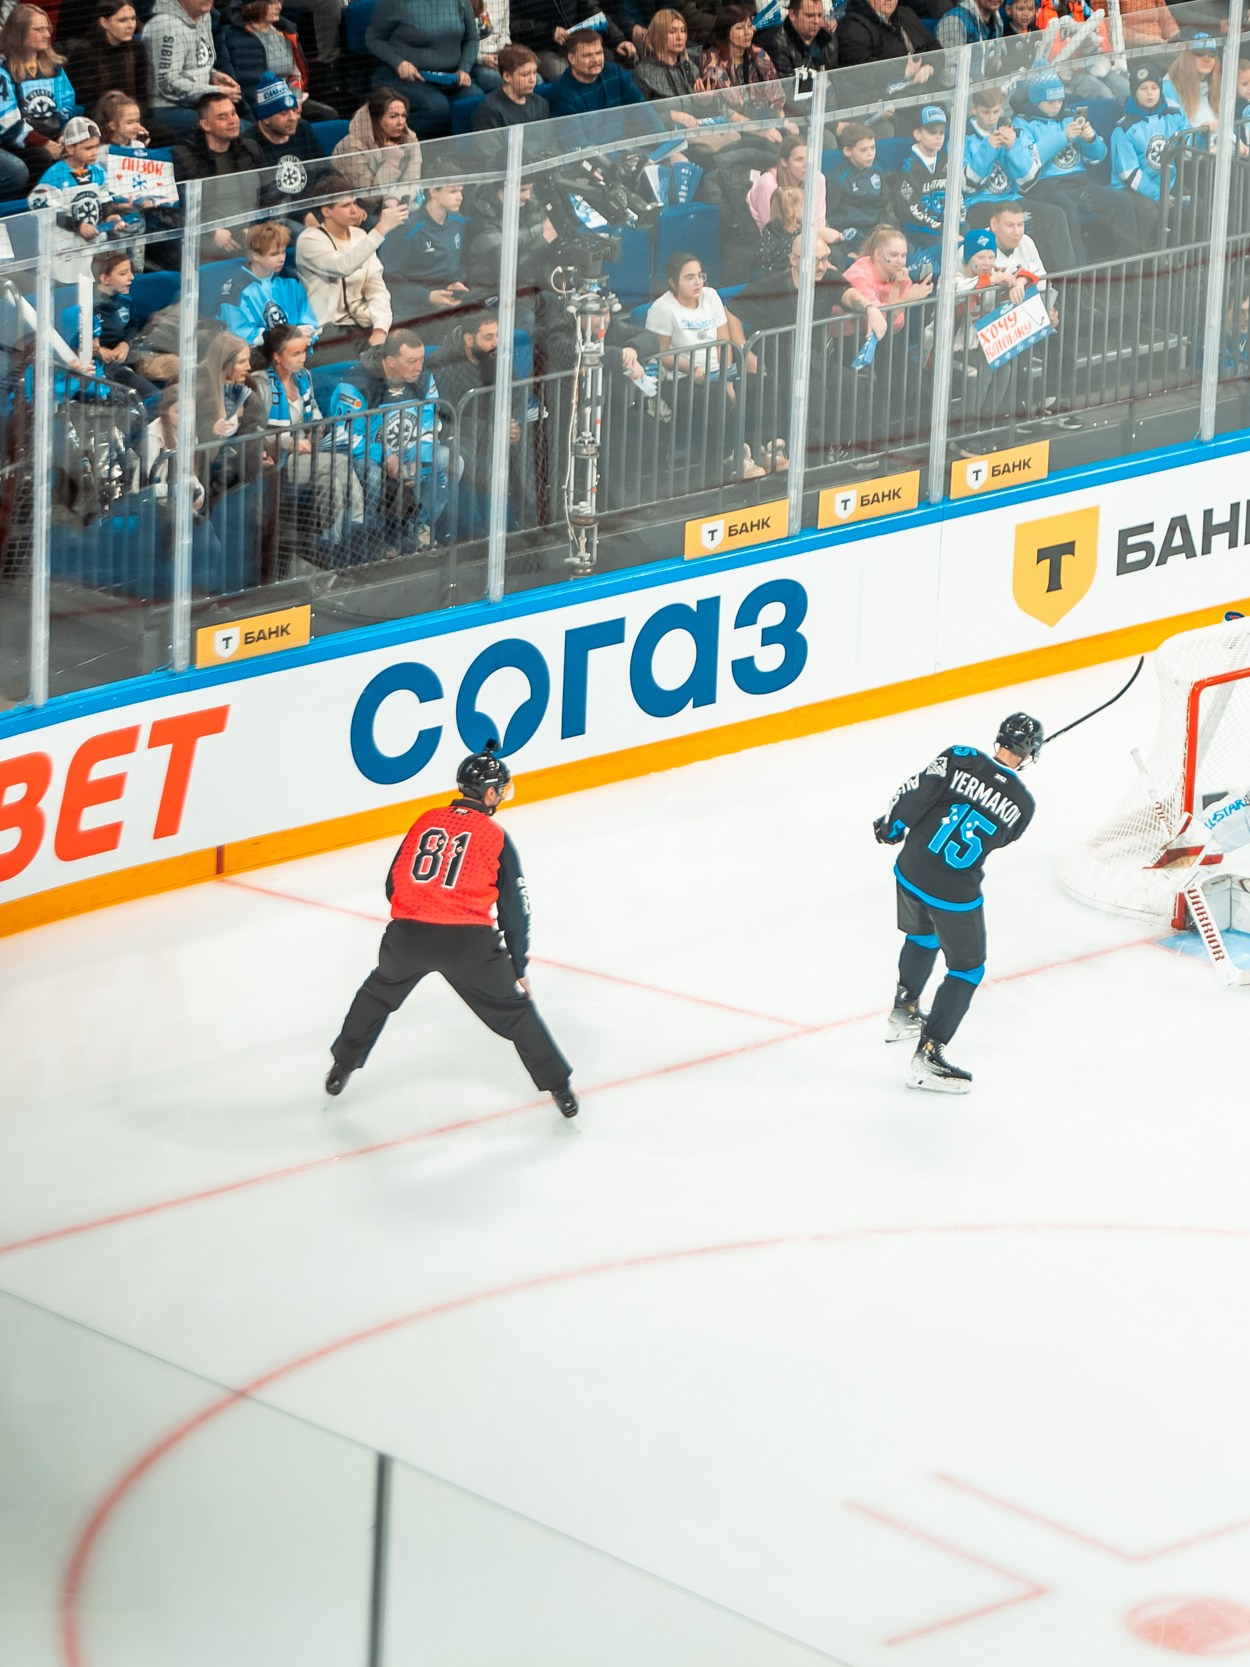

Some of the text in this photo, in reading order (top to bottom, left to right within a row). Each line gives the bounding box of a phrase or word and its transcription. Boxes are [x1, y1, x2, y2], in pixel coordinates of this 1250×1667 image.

[980, 310, 1018, 344] ХОЧУ
[972, 457, 1032, 481] Т БАНК
[841, 487, 902, 511] Т БАНК
[707, 516, 771, 542] Т БАНК
[1036, 540, 1076, 594] Т
[222, 623, 291, 649] Т БАНК
[927, 803, 998, 869] 15
[411, 827, 472, 889] 81
